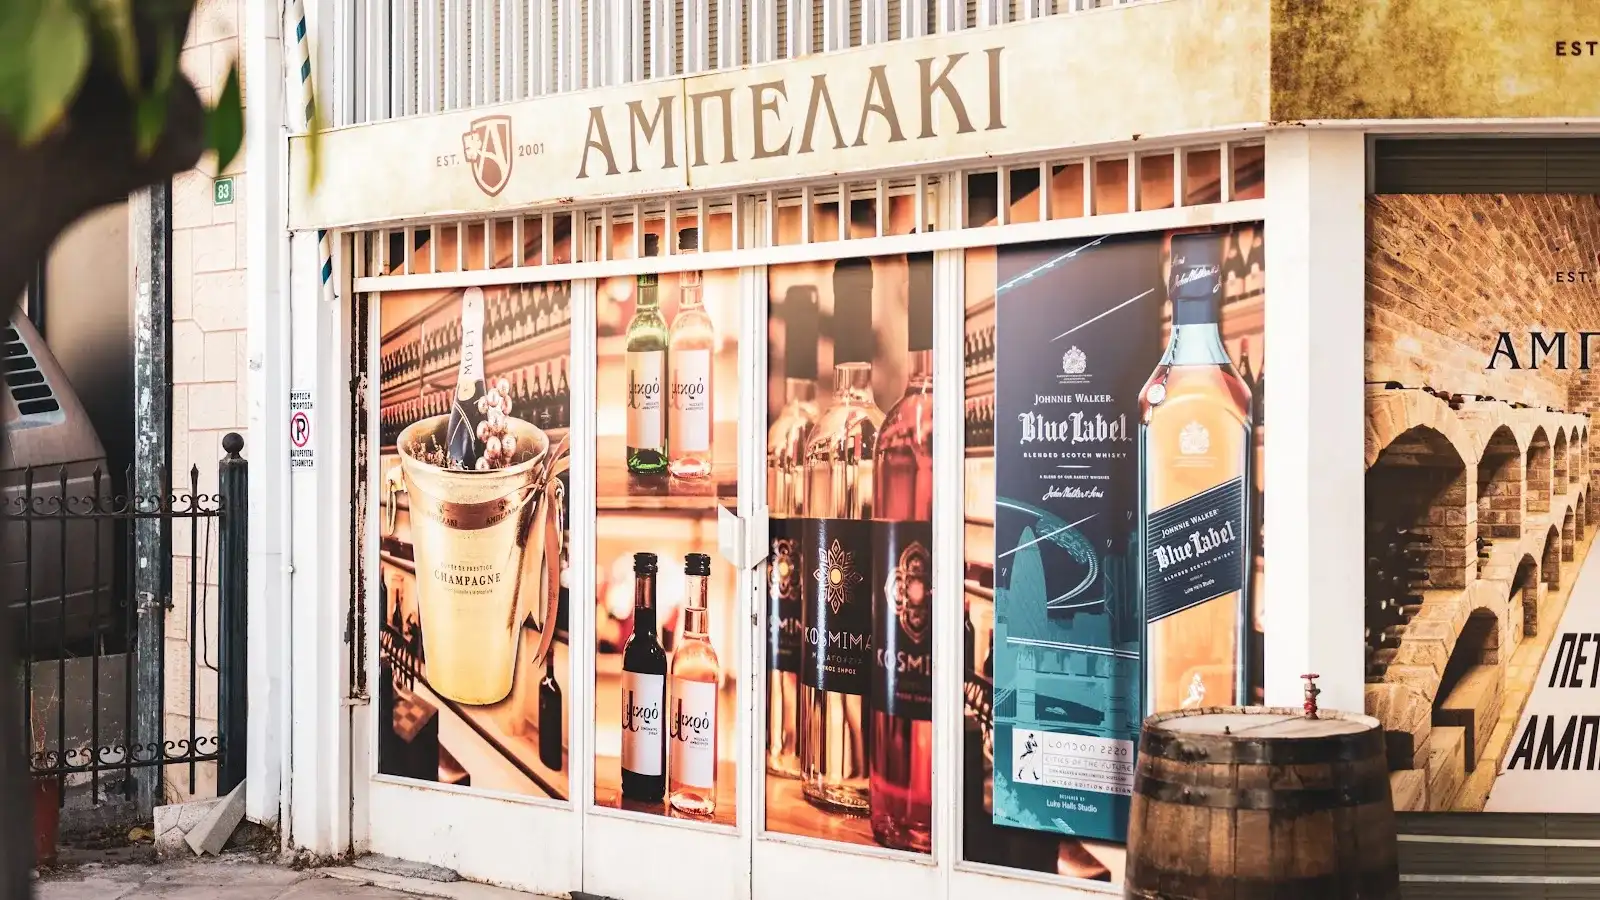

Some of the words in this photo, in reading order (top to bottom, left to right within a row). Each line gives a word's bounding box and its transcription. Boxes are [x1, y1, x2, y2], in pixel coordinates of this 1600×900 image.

[576, 47, 1008, 179] ΑΜΠΕΛΑΚΙ
[436, 154, 460, 167] EST.
[518, 142, 544, 157] 2001
[218, 184, 229, 199] 83
[1556, 271, 1592, 283] EST.
[1034, 394, 1072, 405] JOHNNIE
[1075, 393, 1112, 403] WALKER
[1017, 411, 1068, 445] Blue
[1068, 411, 1128, 445] Label
[1161, 520, 1190, 538] JOHNNIE
[1190, 509, 1218, 525] WALKER
[1152, 542, 1193, 572] Blue
[1189, 520, 1236, 557] Label
[434, 570, 501, 586] CHAMPAGNE
[1164, 568, 1188, 582] BLENDED
[1190, 560, 1211, 572] SCOTCH
[1100, 745, 1127, 756] 2220
[1101, 762, 1132, 772] FUTURE
[1046, 799, 1061, 808] Luke
[1061, 800, 1077, 810] Halls
[1077, 803, 1097, 813] Studio
